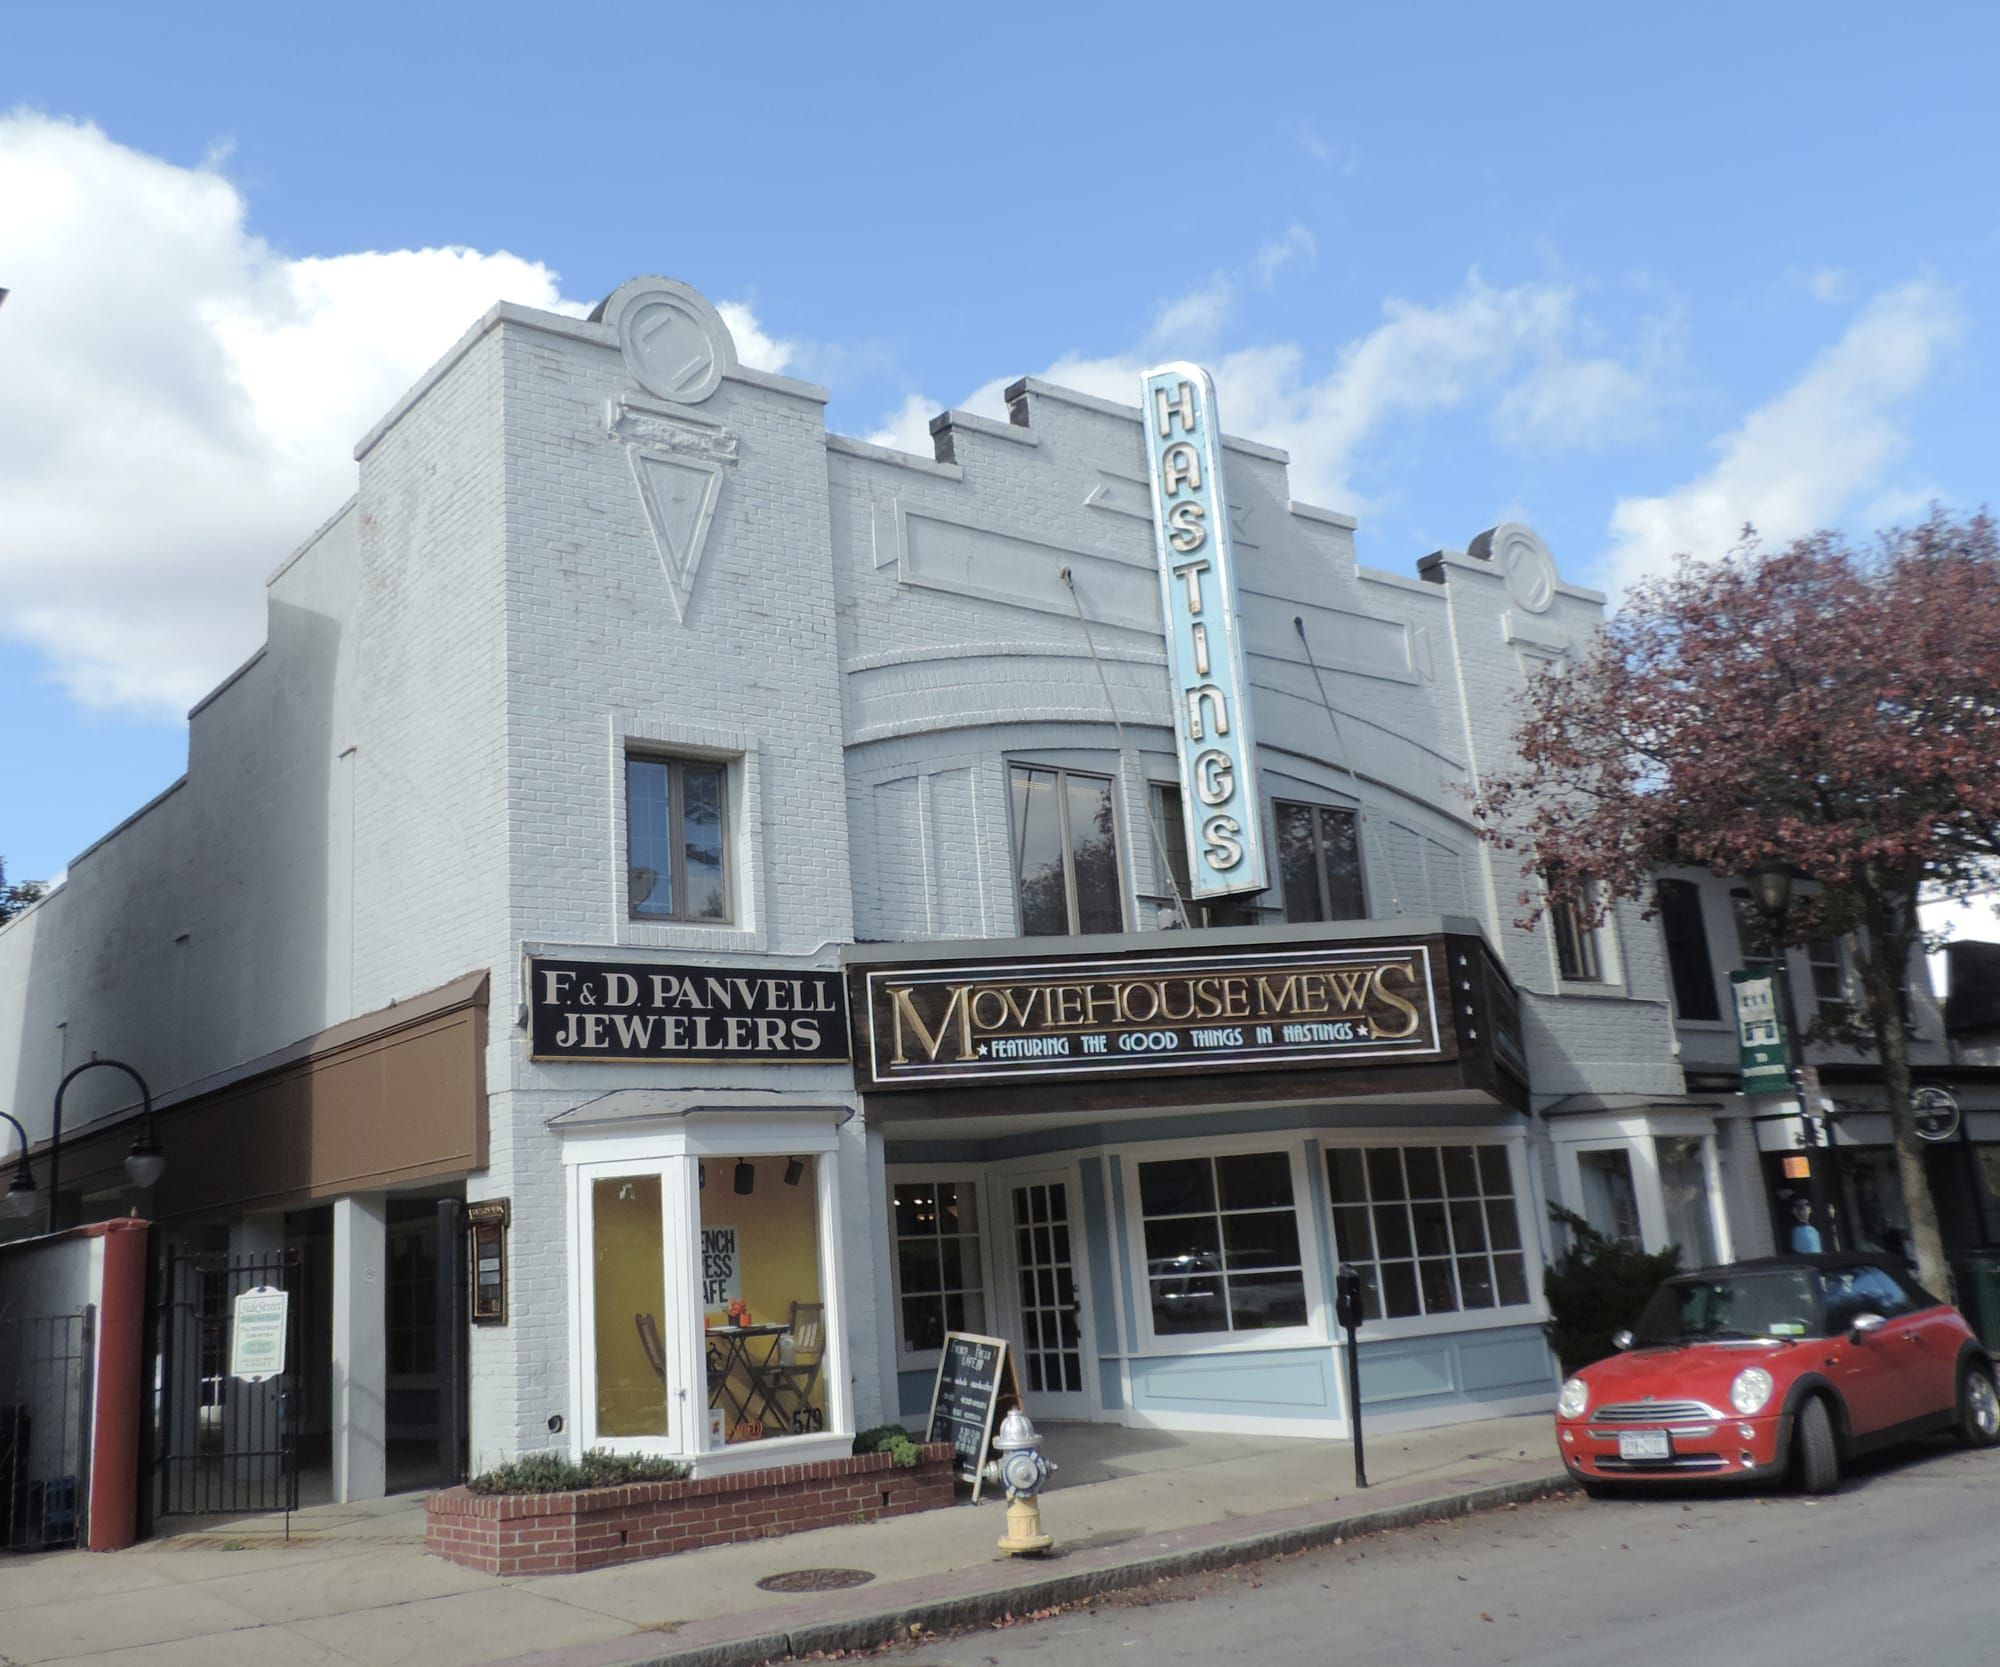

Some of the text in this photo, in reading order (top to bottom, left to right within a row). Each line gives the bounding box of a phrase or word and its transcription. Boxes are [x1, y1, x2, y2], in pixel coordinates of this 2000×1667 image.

[579, 982, 597, 1006] &
[649, 975, 836, 1012] PANVELL
[556, 1013, 822, 1051] JEWELERS
[886, 964, 1420, 1064] MOVIEHOUSE MEWS
[991, 1022, 1354, 1058] FEATURING THE GOOD THINGS IN HASTINGS
[702, 1254, 733, 1279] ESS
[793, 1408, 823, 1434] 579
